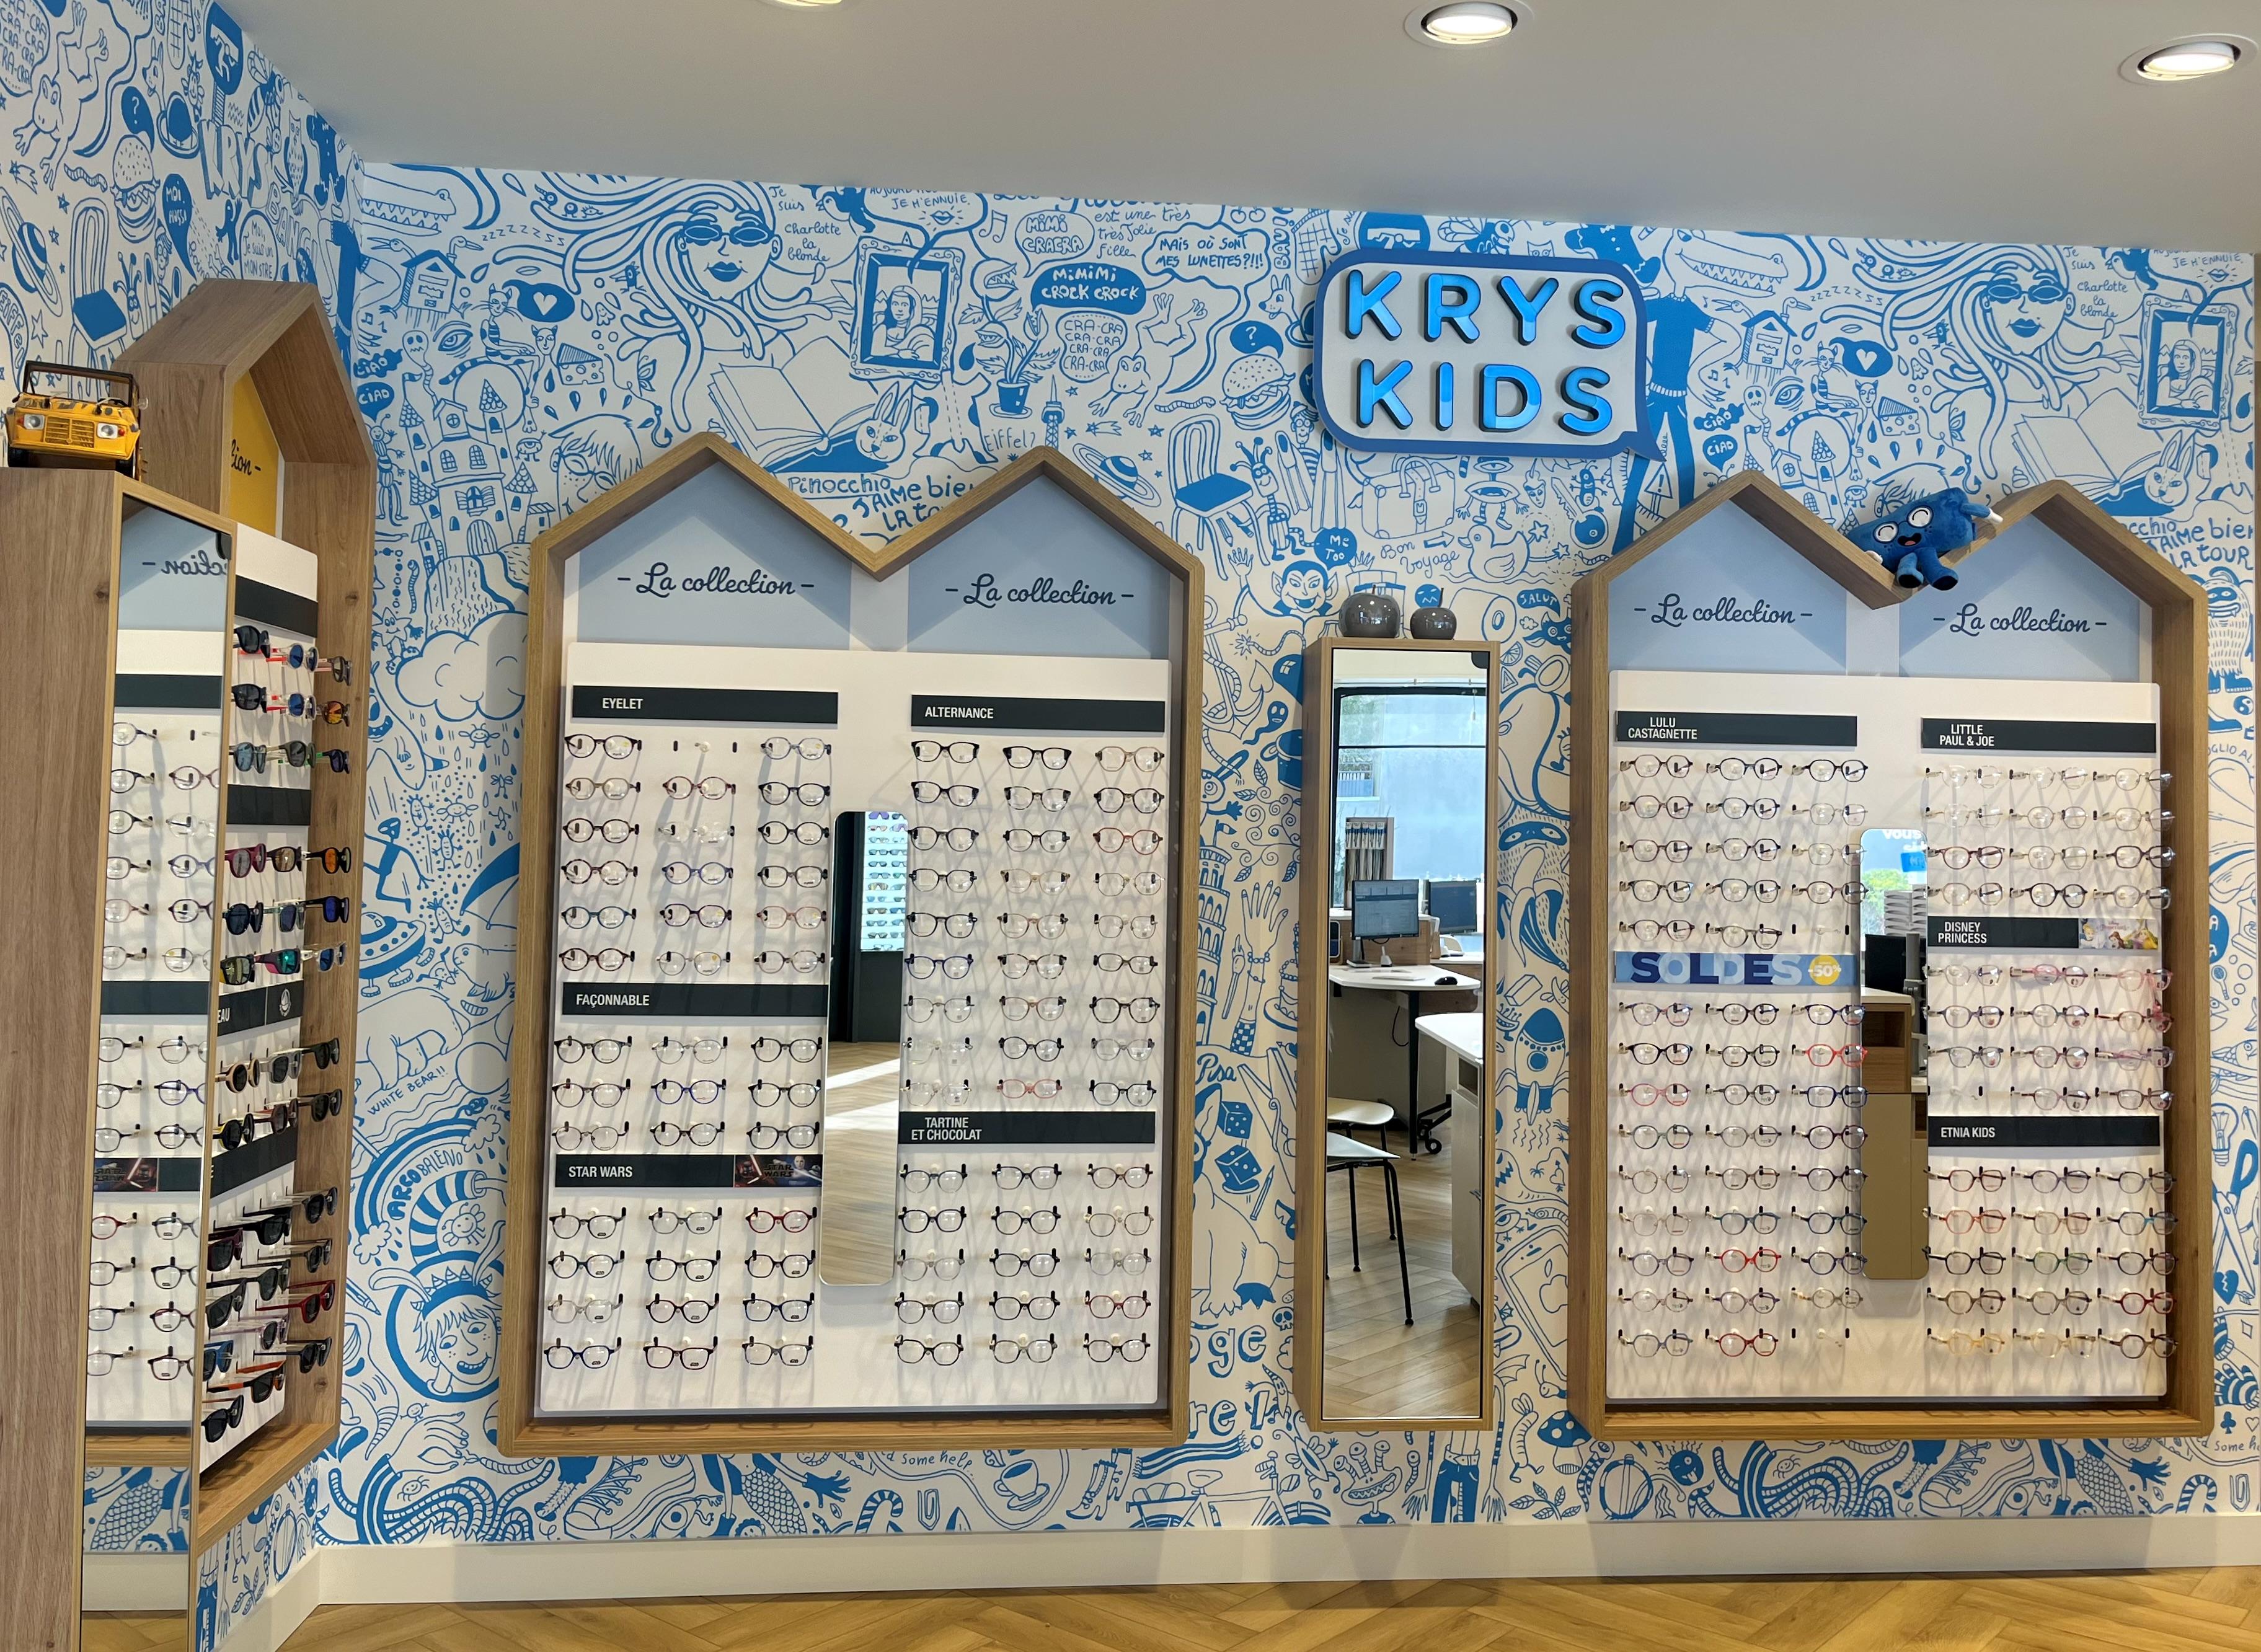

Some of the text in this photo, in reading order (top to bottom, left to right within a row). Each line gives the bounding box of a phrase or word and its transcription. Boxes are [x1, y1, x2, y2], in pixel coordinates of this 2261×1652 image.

[198, 118, 269, 209] KRYS
[769, 185, 787, 198] Je
[779, 199, 805, 211] suis
[892, 197, 909, 210] JE
[1095, 210, 1120, 222] est
[784, 221, 841, 236] Charlotte
[802, 237, 816, 249] la
[787, 247, 831, 262] blonde
[1042, 284, 1139, 301] CROCK CROCK
[2077, 279, 2128, 293] Charlotte
[2093, 296, 2106, 306] la
[1345, 268, 1626, 349] KRYS
[2081, 304, 2118, 318] blonde
[1356, 358, 1613, 434] KIDS
[913, 503, 944, 522] to
[2120, 518, 2177, 536] cchio
[1381, 541, 1415, 559] Bon
[636, 562, 795, 598] La collection
[963, 573, 1116, 608] La collection
[1651, 593, 1795, 627] La collection
[1950, 603, 2090, 636] La collection
[602, 697, 644, 710] EYELET
[924, 706, 994, 719] ALTERNANCE
[1650, 717, 1676, 728] LULU
[1951, 723, 1983, 735] LITTLE
[1628, 728, 1697, 740] CASTAGNETTE
[1939, 735, 1994, 746] PAUL & JOE
[1944, 921, 1981, 932] DISNEY
[1938, 932, 1987, 943] PRINCESS
[1631, 952, 1802, 986] SOLDES
[1808, 965, 1842, 978] -50%
[576, 994, 650, 1009] FAÇONNABLE
[218, 1007, 230, 1023] EAU
[368, 1088, 404, 1115] WHITE
[924, 1118, 969, 1128] TARTINE
[911, 1129, 983, 1141] ET CHOCOLAT
[1940, 1127, 1996, 1138] ETNIA KIDS
[569, 1165, 633, 1178] STAR WARS
